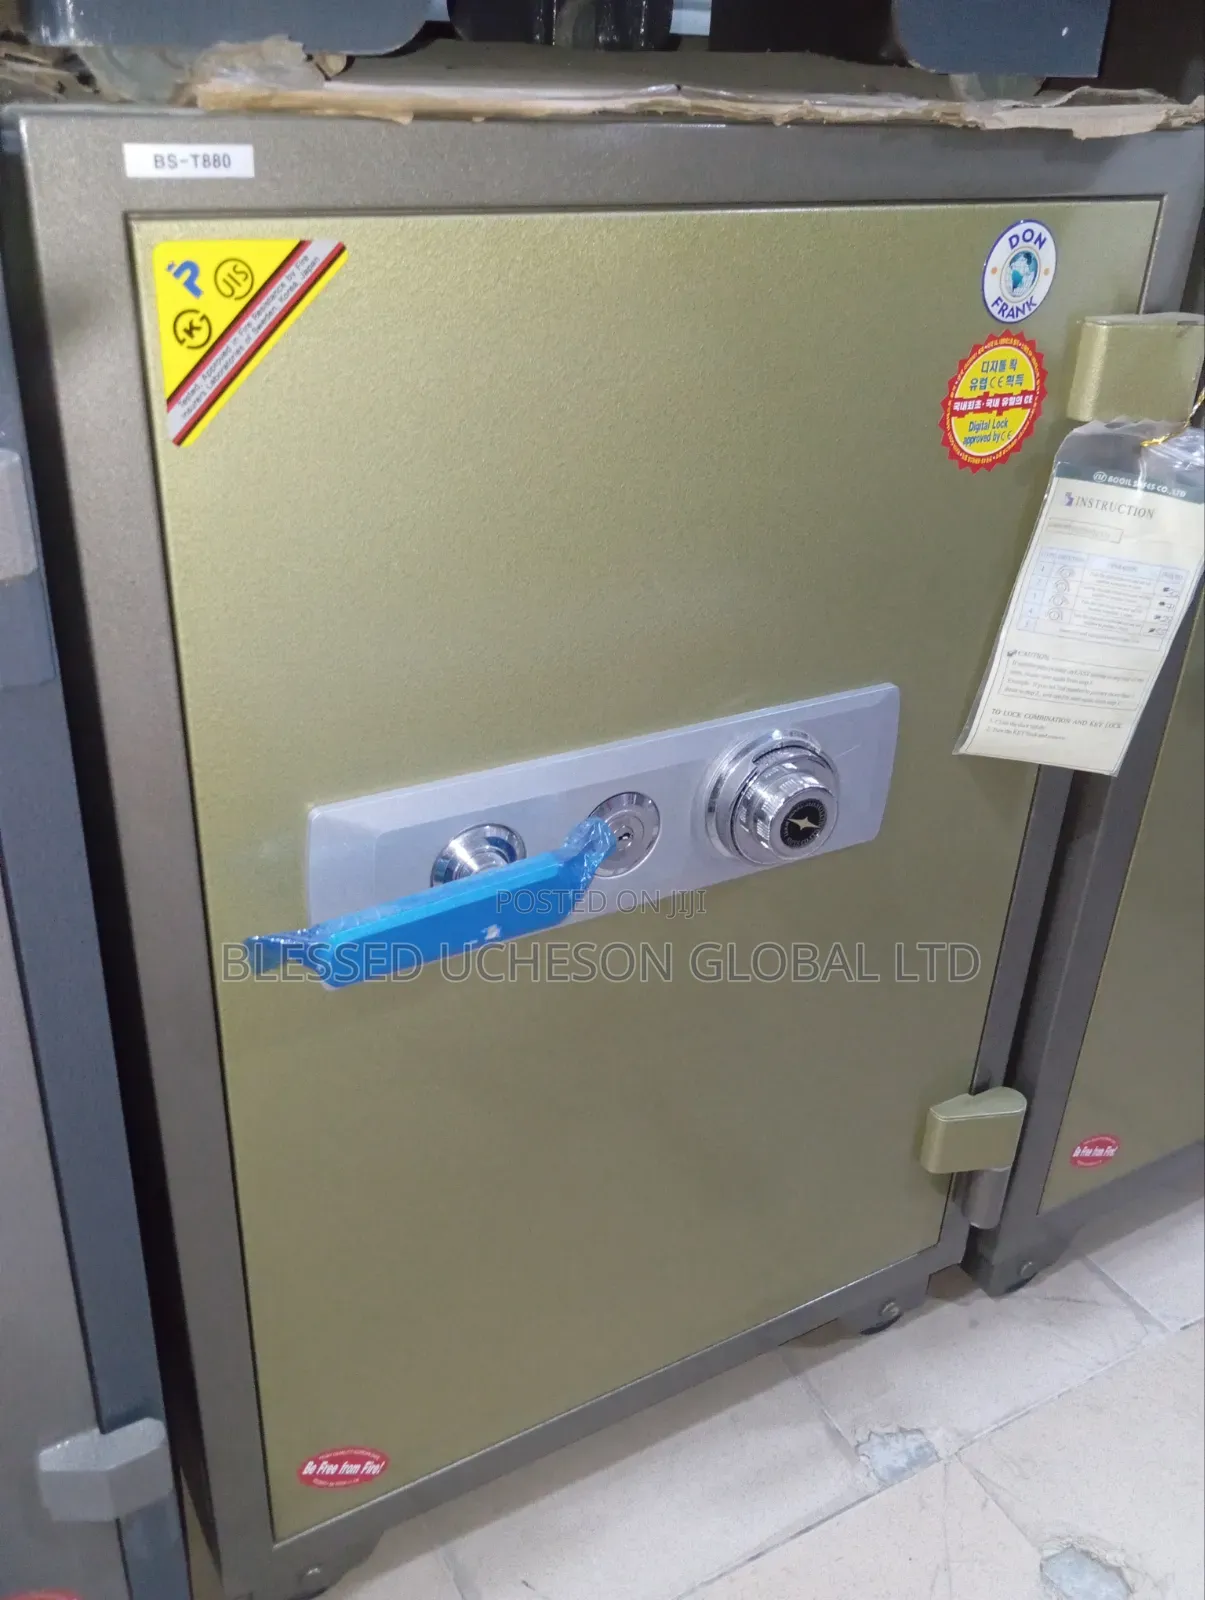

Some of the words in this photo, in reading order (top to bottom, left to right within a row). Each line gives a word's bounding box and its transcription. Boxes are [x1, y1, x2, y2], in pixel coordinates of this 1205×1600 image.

[153, 153, 231, 169] BS-T880
[1008, 227, 1047, 251] DON
[990, 295, 1037, 320] FRANK
[201, 345, 232, 382] Approved
[238, 321, 253, 337] Fire
[252, 281, 286, 321] Resistance
[285, 270, 296, 282] by
[295, 254, 309, 270] Fire
[206, 346, 245, 391] Laboratories
[299, 256, 321, 281] Japan
[968, 418, 990, 433] Digital
[992, 417, 1008, 429] Lock
[963, 430, 991, 447] approved
[992, 431, 1001, 444] by
[1107, 475, 1133, 487] BOOIL
[1075, 495, 1155, 519] INSTRUCTION
[1002, 710, 1021, 718] LOCK
[1024, 712, 1071, 724] COMBINATION
[1072, 718, 1087, 726] AND
[302, 1461, 317, 1475] Be
[316, 1460, 339, 1475] Free
[338, 1460, 361, 1475] from
[360, 1460, 386, 1475] Fire!
